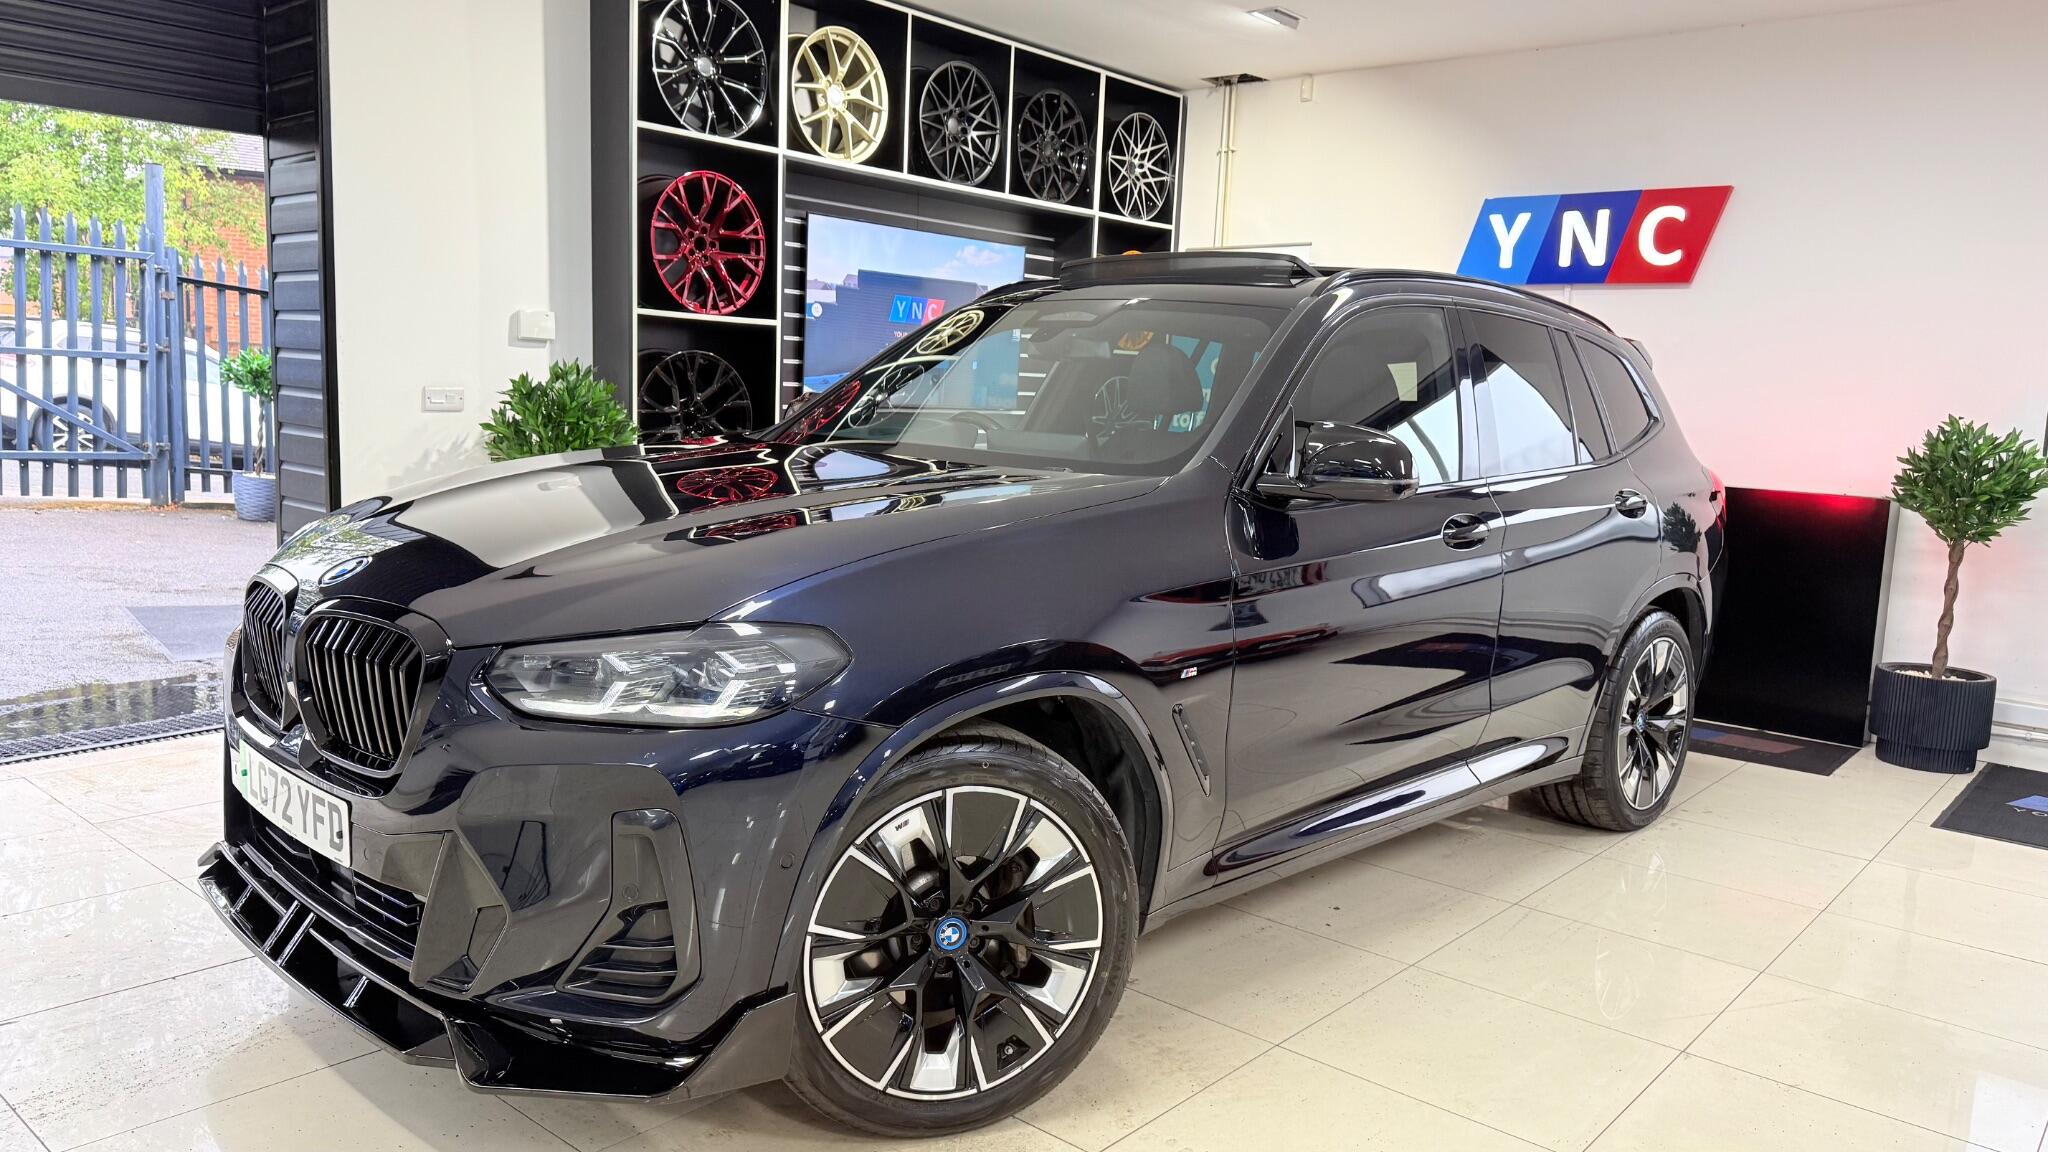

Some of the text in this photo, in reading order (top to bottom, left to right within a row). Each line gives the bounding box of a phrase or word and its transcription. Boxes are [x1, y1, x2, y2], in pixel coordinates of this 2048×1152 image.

[1488, 204, 1687, 270] YNC
[896, 300, 938, 321] YNC
[249, 750, 344, 852] LG72 YFD
